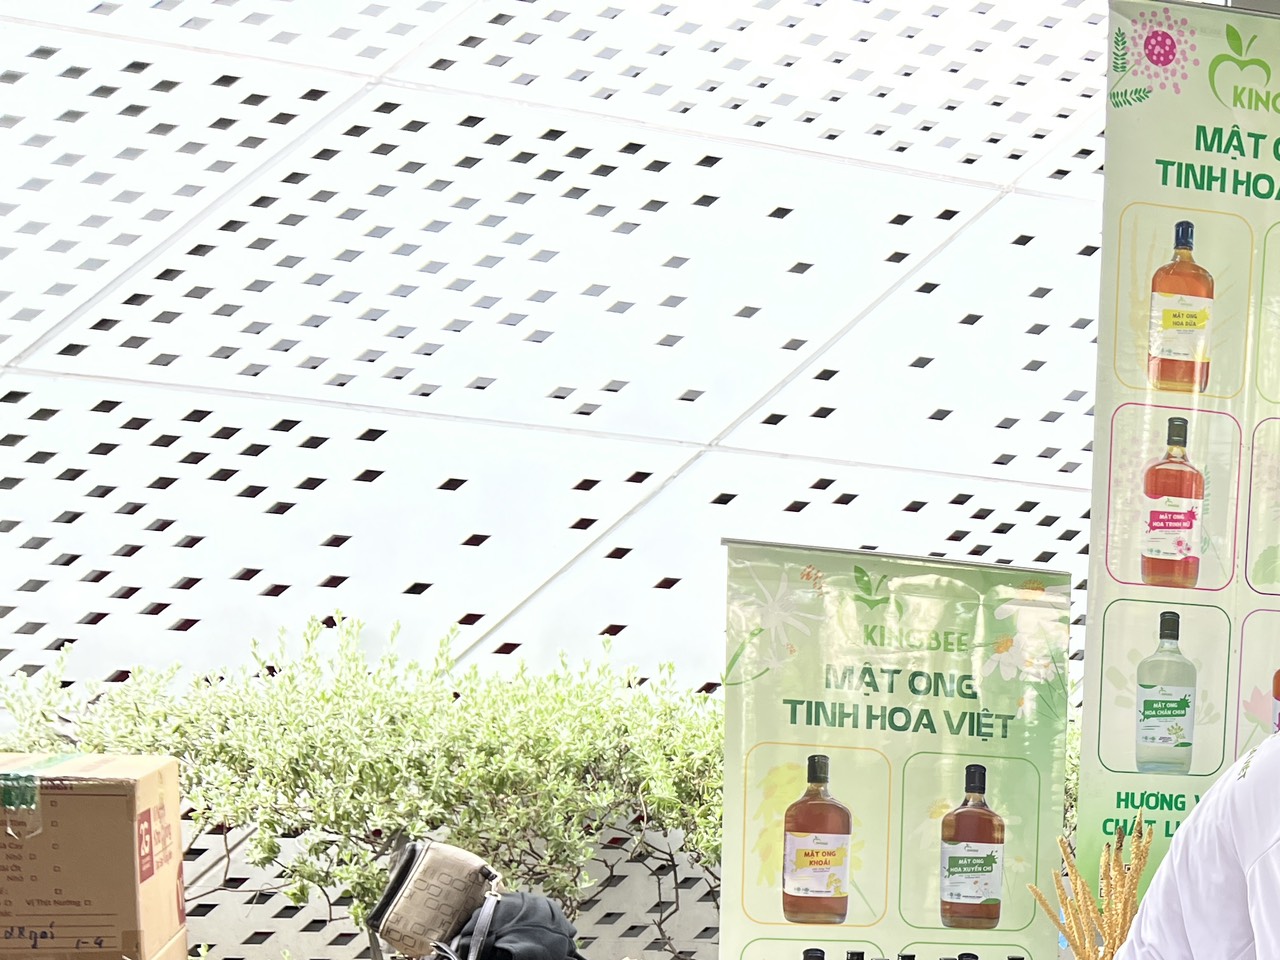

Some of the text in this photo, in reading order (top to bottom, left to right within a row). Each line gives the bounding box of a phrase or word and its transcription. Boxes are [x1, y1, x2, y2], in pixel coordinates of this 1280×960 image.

[1195, 124, 1267, 160] MẬT
[1155, 159, 1227, 193] TINH
[863, 624, 969, 653] KINGBEE
[825, 662, 978, 699] MẬT ONG
[782, 698, 1015, 741] TINH HOA VIỆT
[1116, 791, 1186, 811] HƯƠNG
